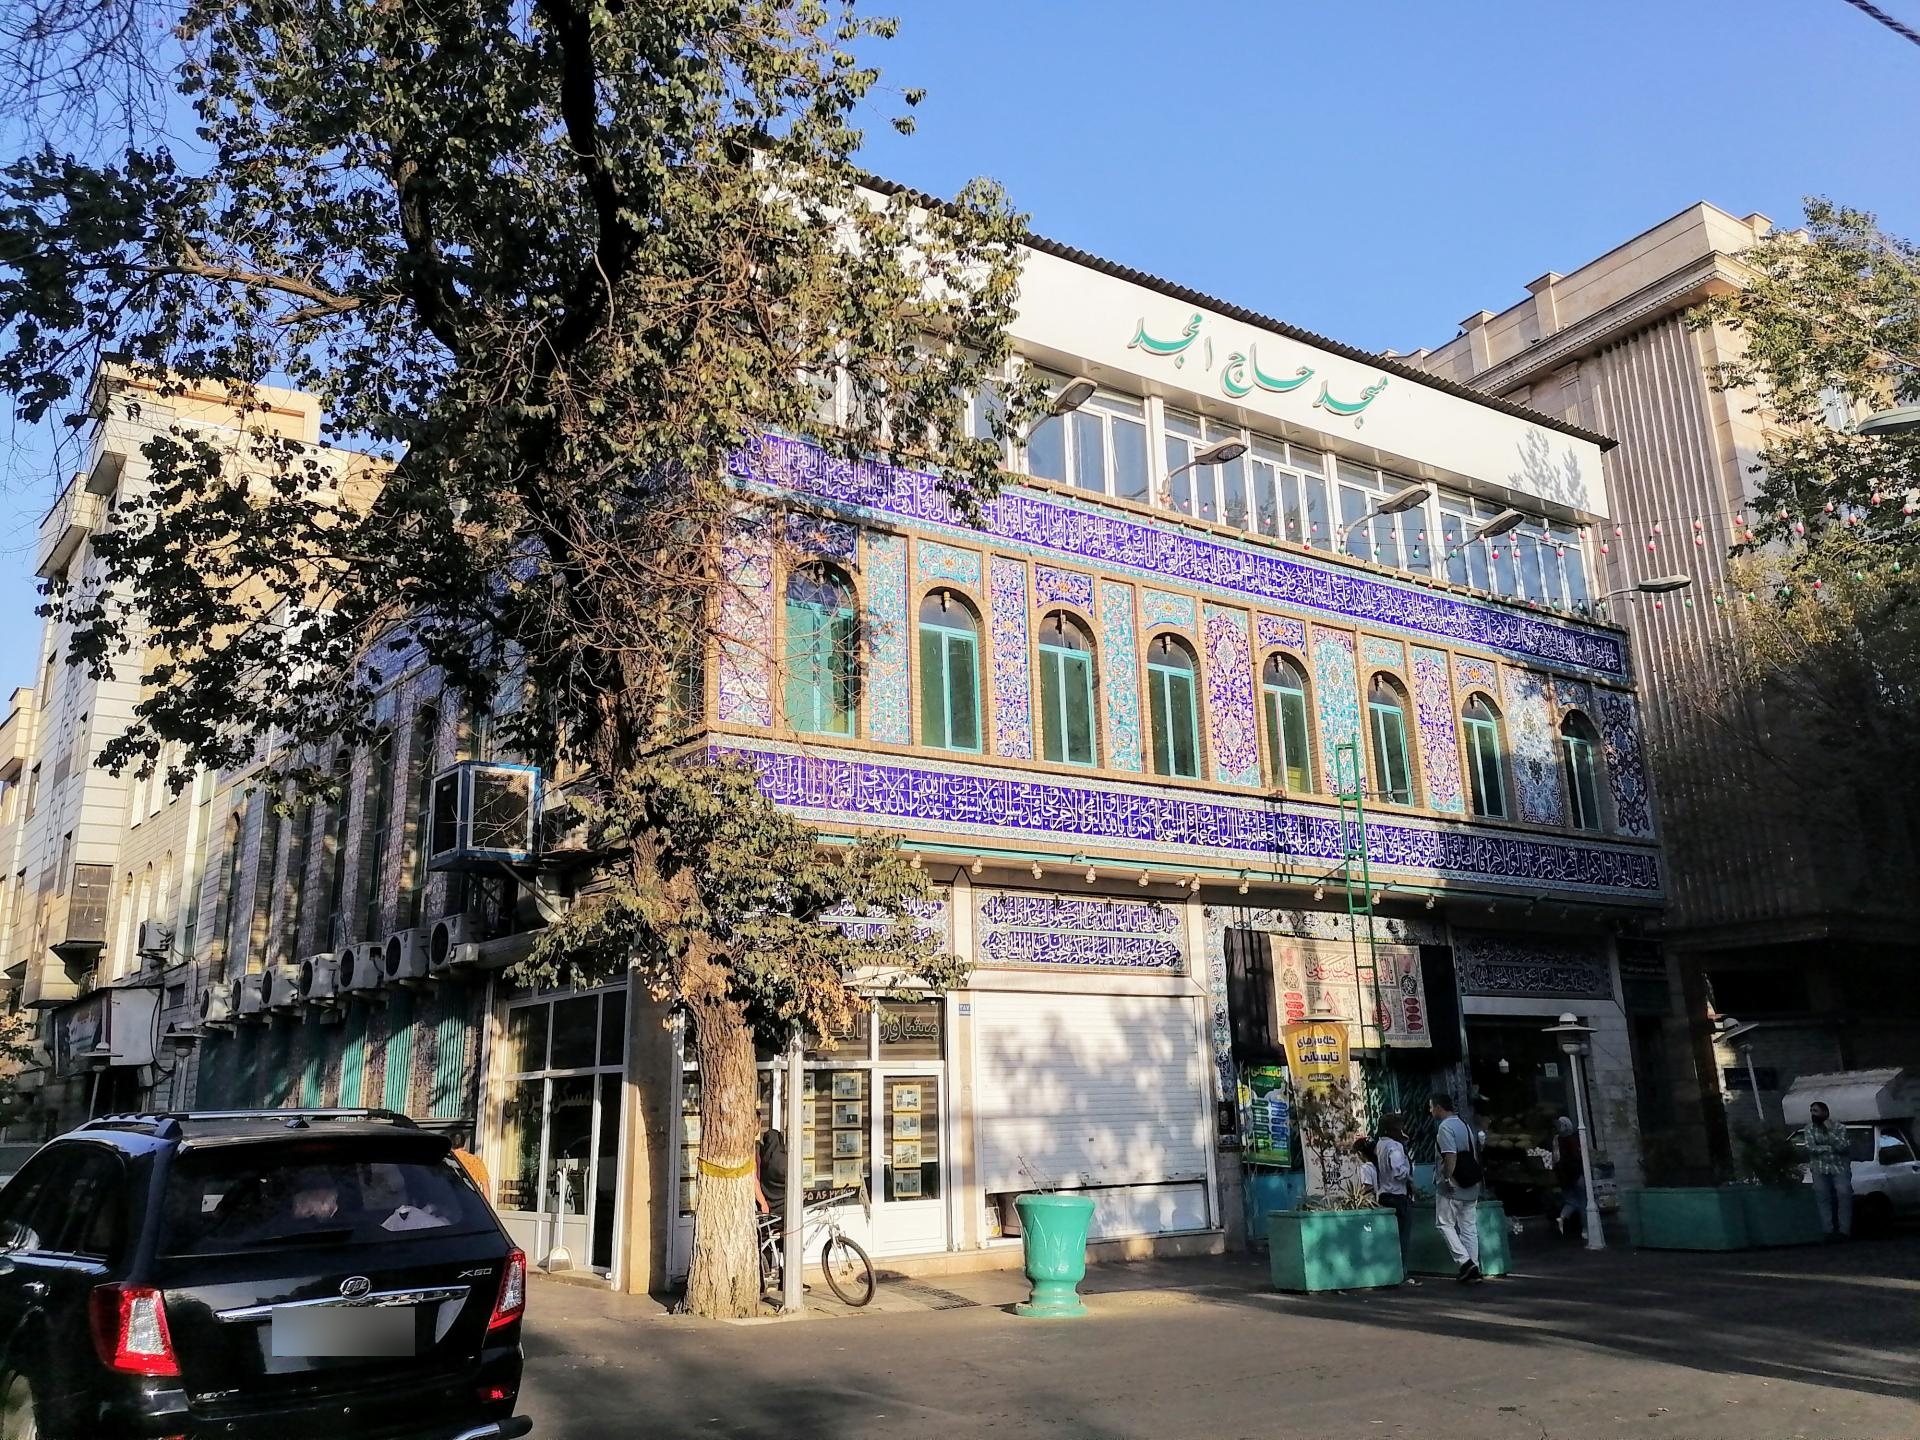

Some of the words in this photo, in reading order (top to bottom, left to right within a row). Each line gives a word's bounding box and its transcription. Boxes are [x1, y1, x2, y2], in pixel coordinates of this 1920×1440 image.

[1126, 311, 1213, 370] امجد
[1219, 342, 1315, 399] حاج
[1312, 375, 1389, 430] مسجد
[879, 1013, 940, 1042] مشاور
[457, 1267, 493, 1279] X60
